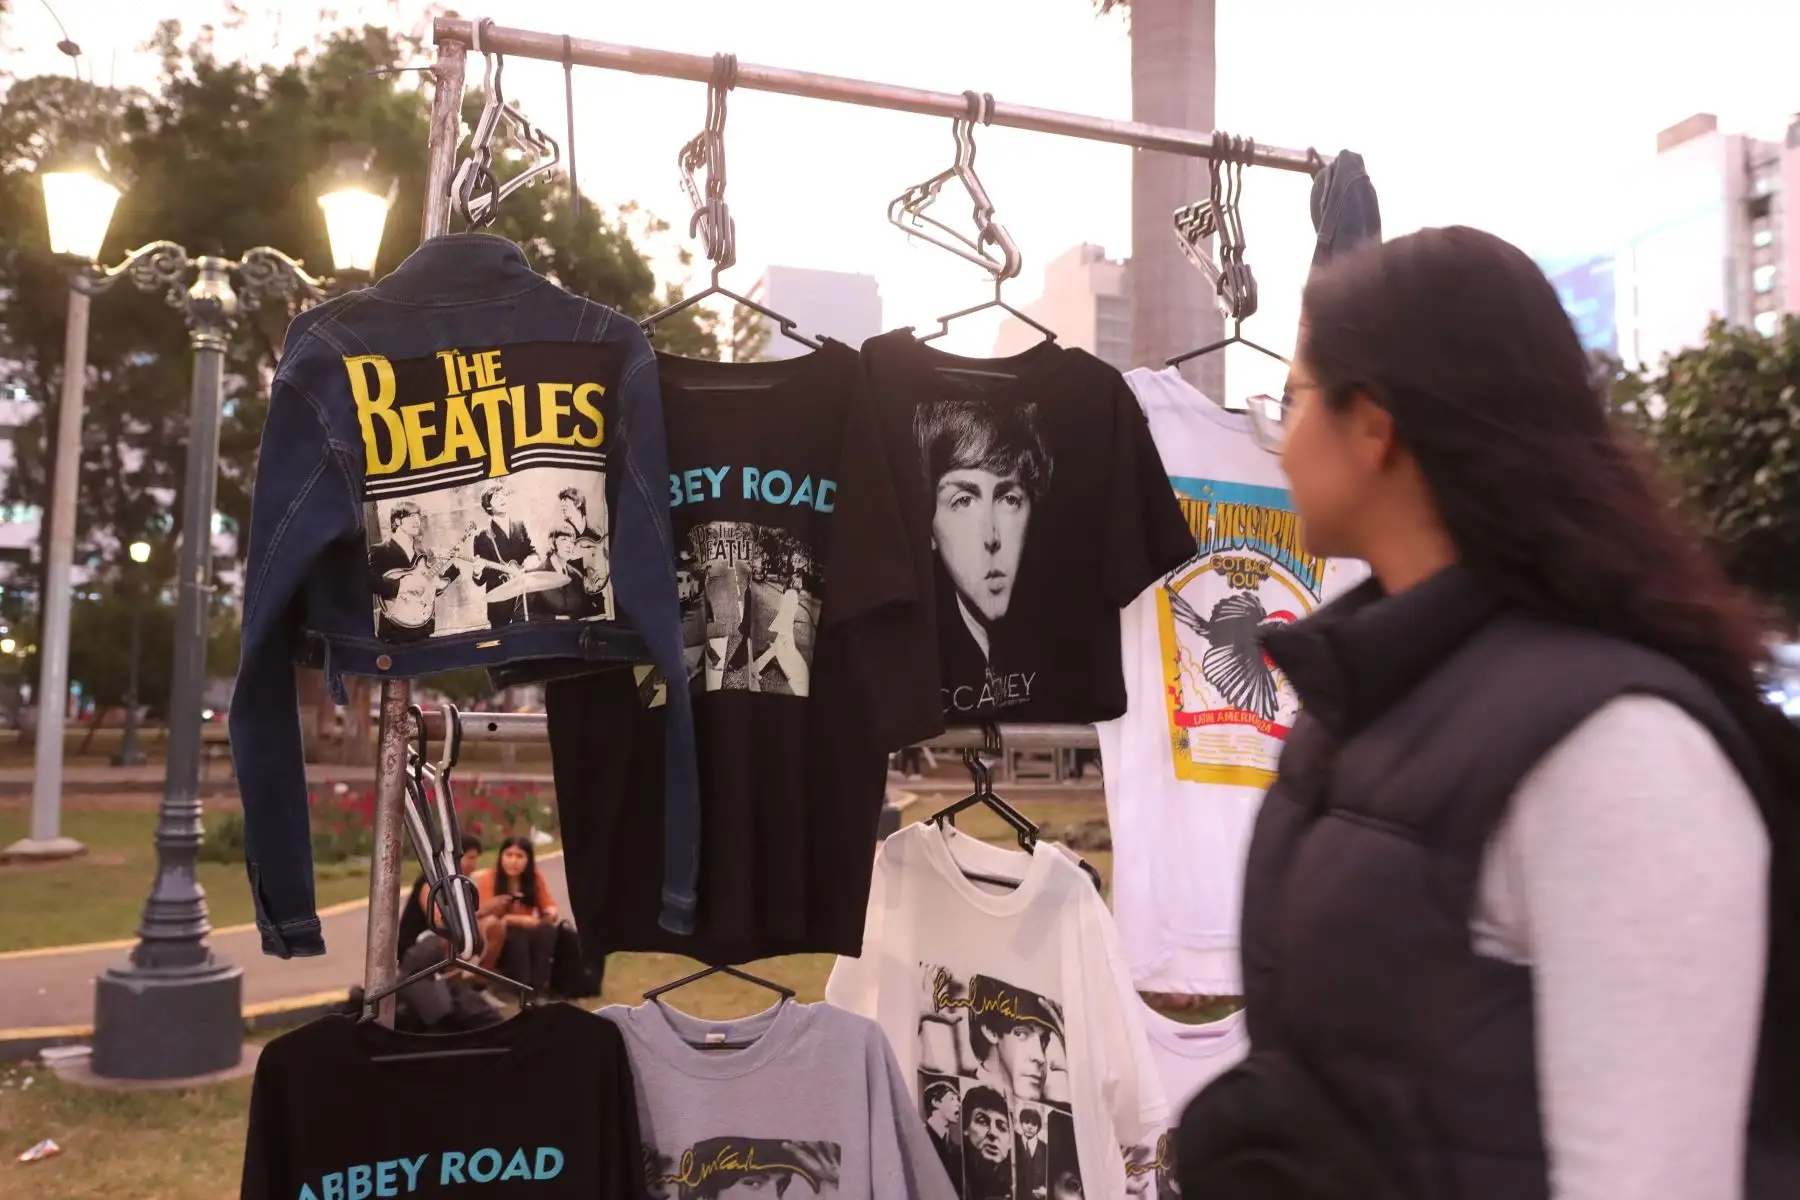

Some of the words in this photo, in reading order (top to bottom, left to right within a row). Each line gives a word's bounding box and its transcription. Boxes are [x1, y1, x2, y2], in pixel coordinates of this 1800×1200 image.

[437, 349, 506, 396] THE
[342, 354, 606, 478] BEATLES
[743, 467, 837, 513] ROAD
[1210, 555, 1243, 572] GOT
[1244, 557, 1272, 575] BACK
[1226, 572, 1260, 590] TOUR
[440, 1147, 564, 1186] ROAD
